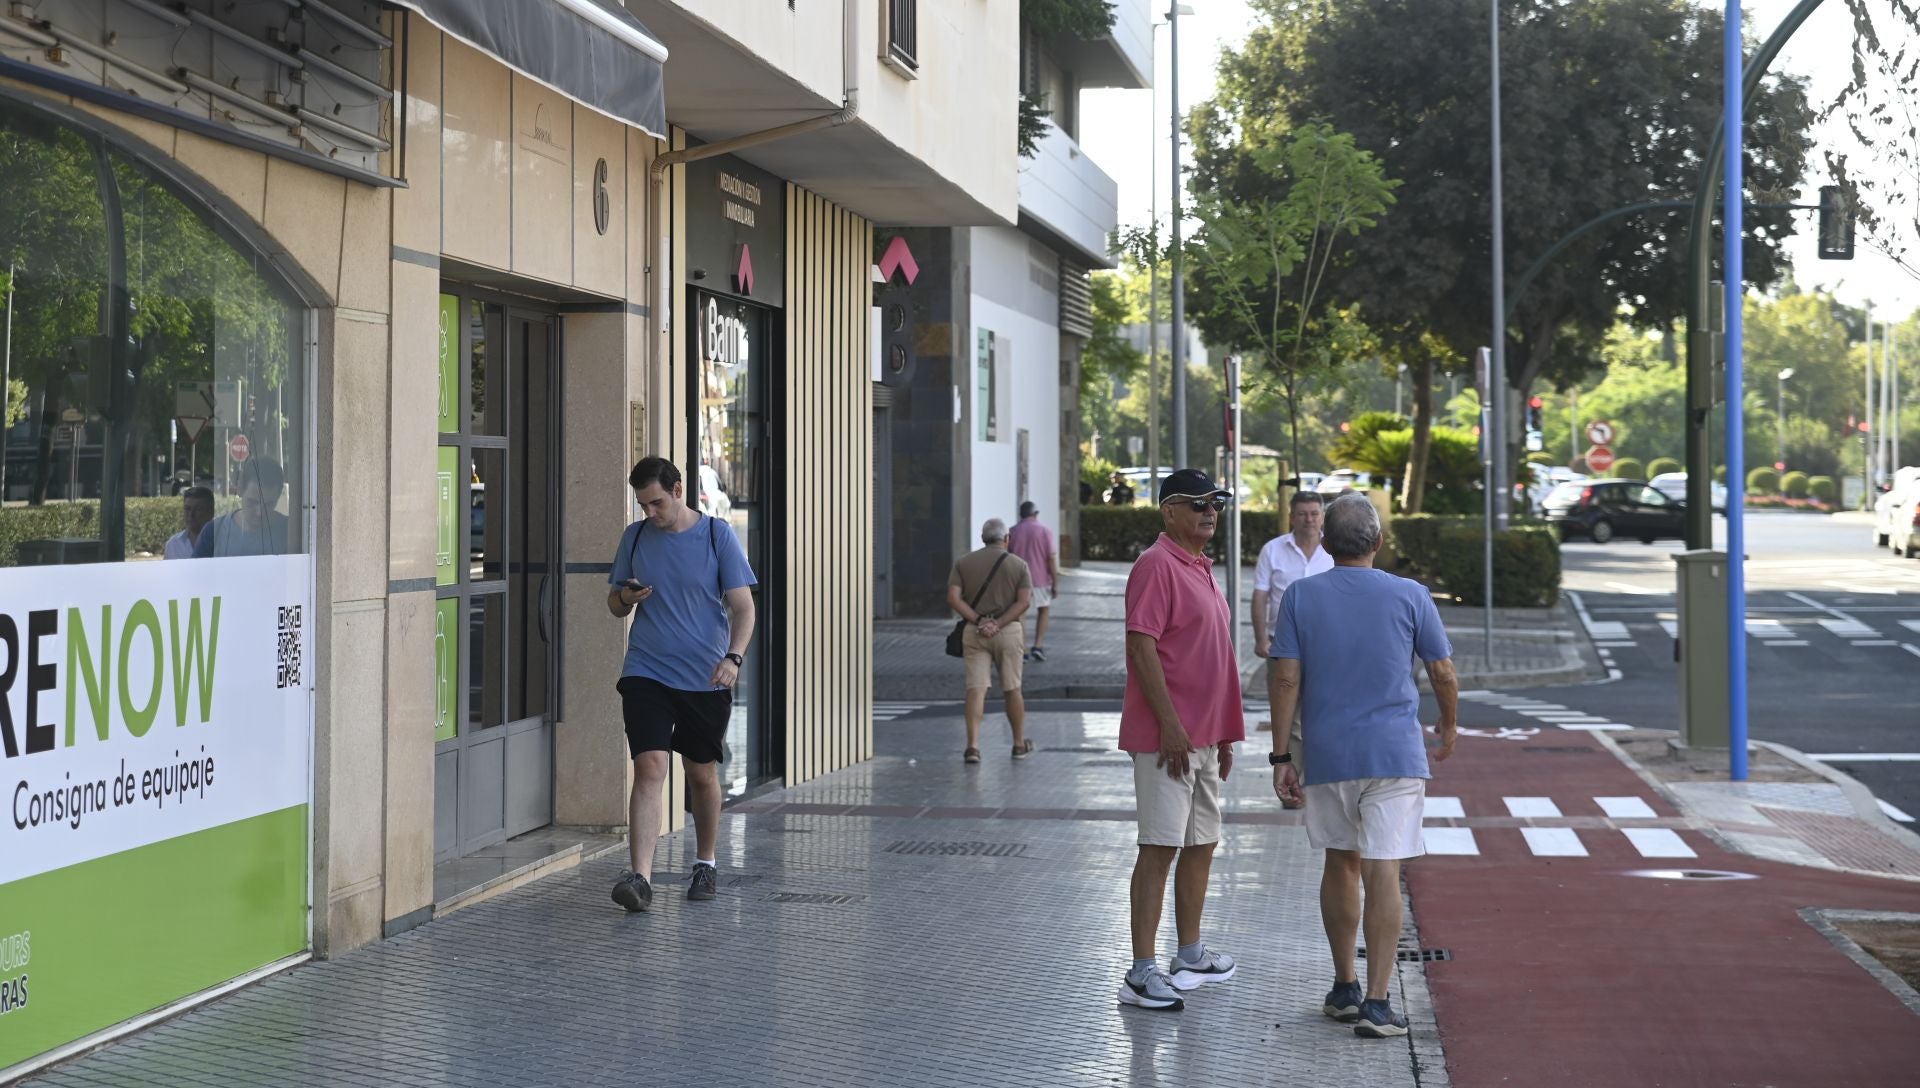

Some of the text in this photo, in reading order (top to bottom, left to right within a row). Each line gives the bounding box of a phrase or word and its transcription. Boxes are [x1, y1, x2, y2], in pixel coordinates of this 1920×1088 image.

[593, 157, 610, 236] 6
[13, 744, 214, 830] Consigna de equipaje
[0, 930, 31, 972] URS
